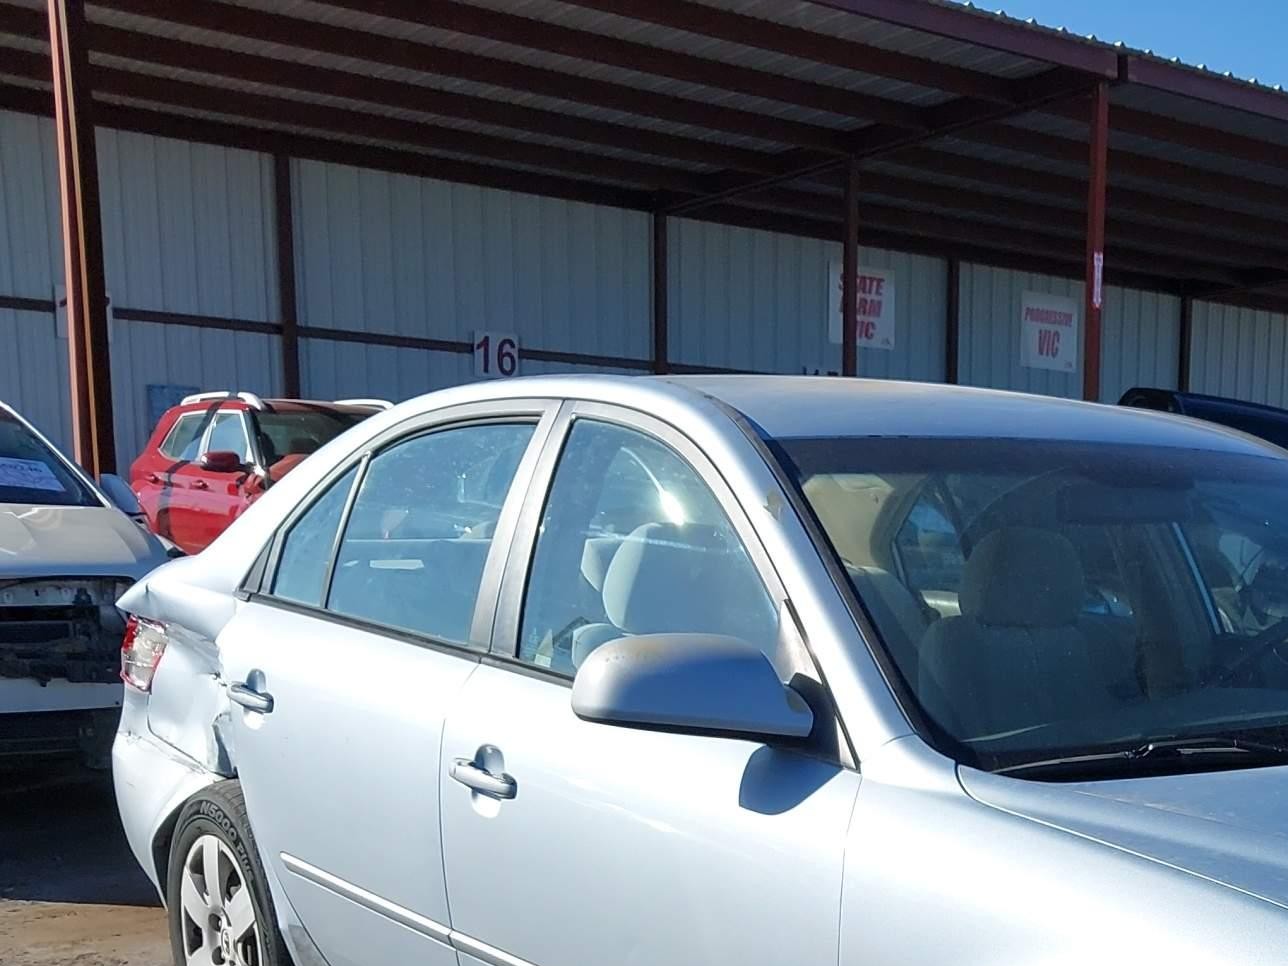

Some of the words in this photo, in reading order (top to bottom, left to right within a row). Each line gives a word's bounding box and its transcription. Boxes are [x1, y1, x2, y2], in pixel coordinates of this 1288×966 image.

[475, 335, 516, 377] 16
[1038, 328, 1061, 360] VIC
[200, 800, 238, 843] N5000
